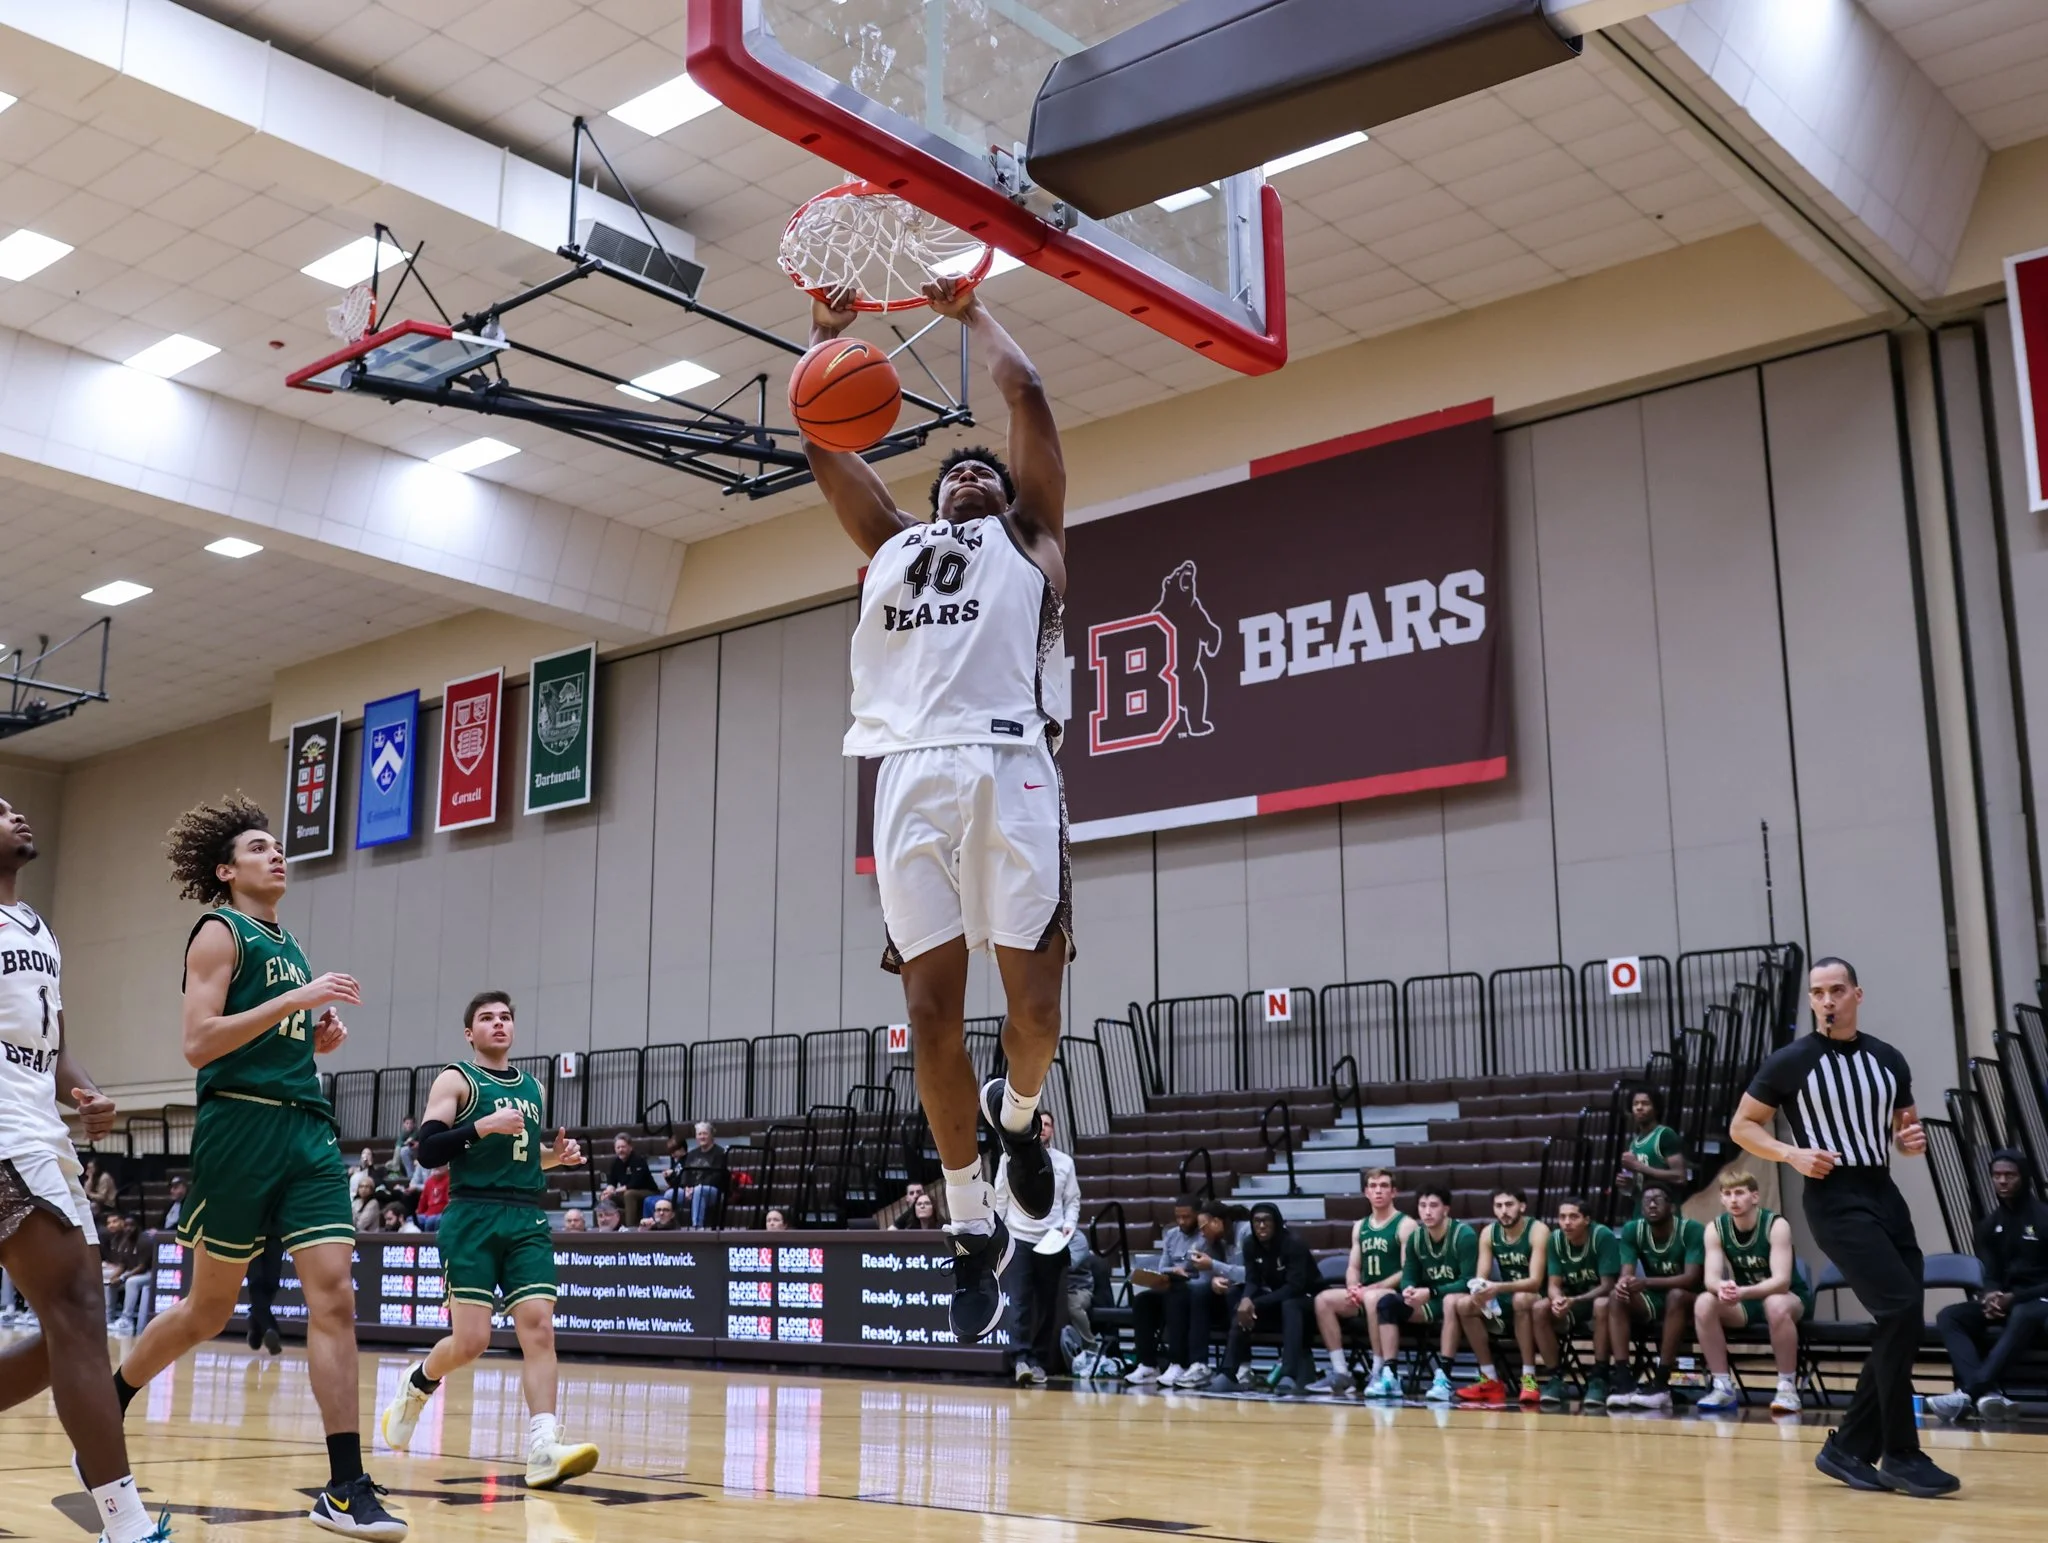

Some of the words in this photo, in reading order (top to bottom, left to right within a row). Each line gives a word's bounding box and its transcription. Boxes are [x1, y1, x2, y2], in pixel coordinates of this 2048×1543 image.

[904, 545, 970, 599] 40
[883, 599, 979, 632] BEARS
[1238, 568, 1487, 686] BEARS
[1088, 611, 1181, 757] B
[534, 764, 582, 788] Dartmouth
[451, 787, 482, 806] Cornell
[296, 825, 320, 838] Brown
[2, 950, 58, 978] BROW
[265, 956, 308, 988] ELMS
[1612, 963, 1636, 988] O
[38, 985, 50, 1038] 1
[1268, 993, 1287, 1016] N
[889, 1028, 906, 1049] M
[563, 1057, 572, 1074] L
[512, 1128, 529, 1162] 2
[729, 1247, 758, 1257] FLOOR
[778, 1247, 809, 1258] FLOOR
[1362, 1236, 1388, 1253] ELMS
[571, 1253, 592, 1265] Now
[593, 1254, 616, 1268] open
[618, 1252, 627, 1265] in
[628, 1252, 651, 1266] West
[653, 1252, 696, 1266] Warwick.
[729, 1257, 758, 1267] DECOR
[778, 1258, 809, 1267] DECOR
[862, 1253, 903, 1272] Ready,
[905, 1255, 929, 1270] set,
[1367, 1255, 1381, 1276] 11
[1426, 1264, 1454, 1280] ELMS
[570, 1284, 591, 1297] Now
[592, 1285, 616, 1300] open
[617, 1284, 626, 1297] in
[627, 1285, 650, 1298] West
[652, 1285, 695, 1299] Warwick.
[729, 1281, 758, 1291] FLOOR
[778, 1282, 809, 1292] FLOOR
[729, 1291, 758, 1300] DECOR
[778, 1292, 809, 1302] DECOR
[862, 1288, 903, 1308] Ready,
[905, 1291, 929, 1307] set,
[569, 1315, 590, 1328] Now
[591, 1317, 615, 1332] open
[616, 1316, 625, 1330] in
[627, 1317, 650, 1331] West
[651, 1318, 694, 1332] Warwick.
[728, 1315, 758, 1325] FLOOR
[778, 1316, 809, 1326] FLOOR
[728, 1325, 758, 1335] DECOR
[778, 1326, 809, 1337] DECOR
[862, 1324, 903, 1344] Ready,
[905, 1327, 929, 1344] set,
